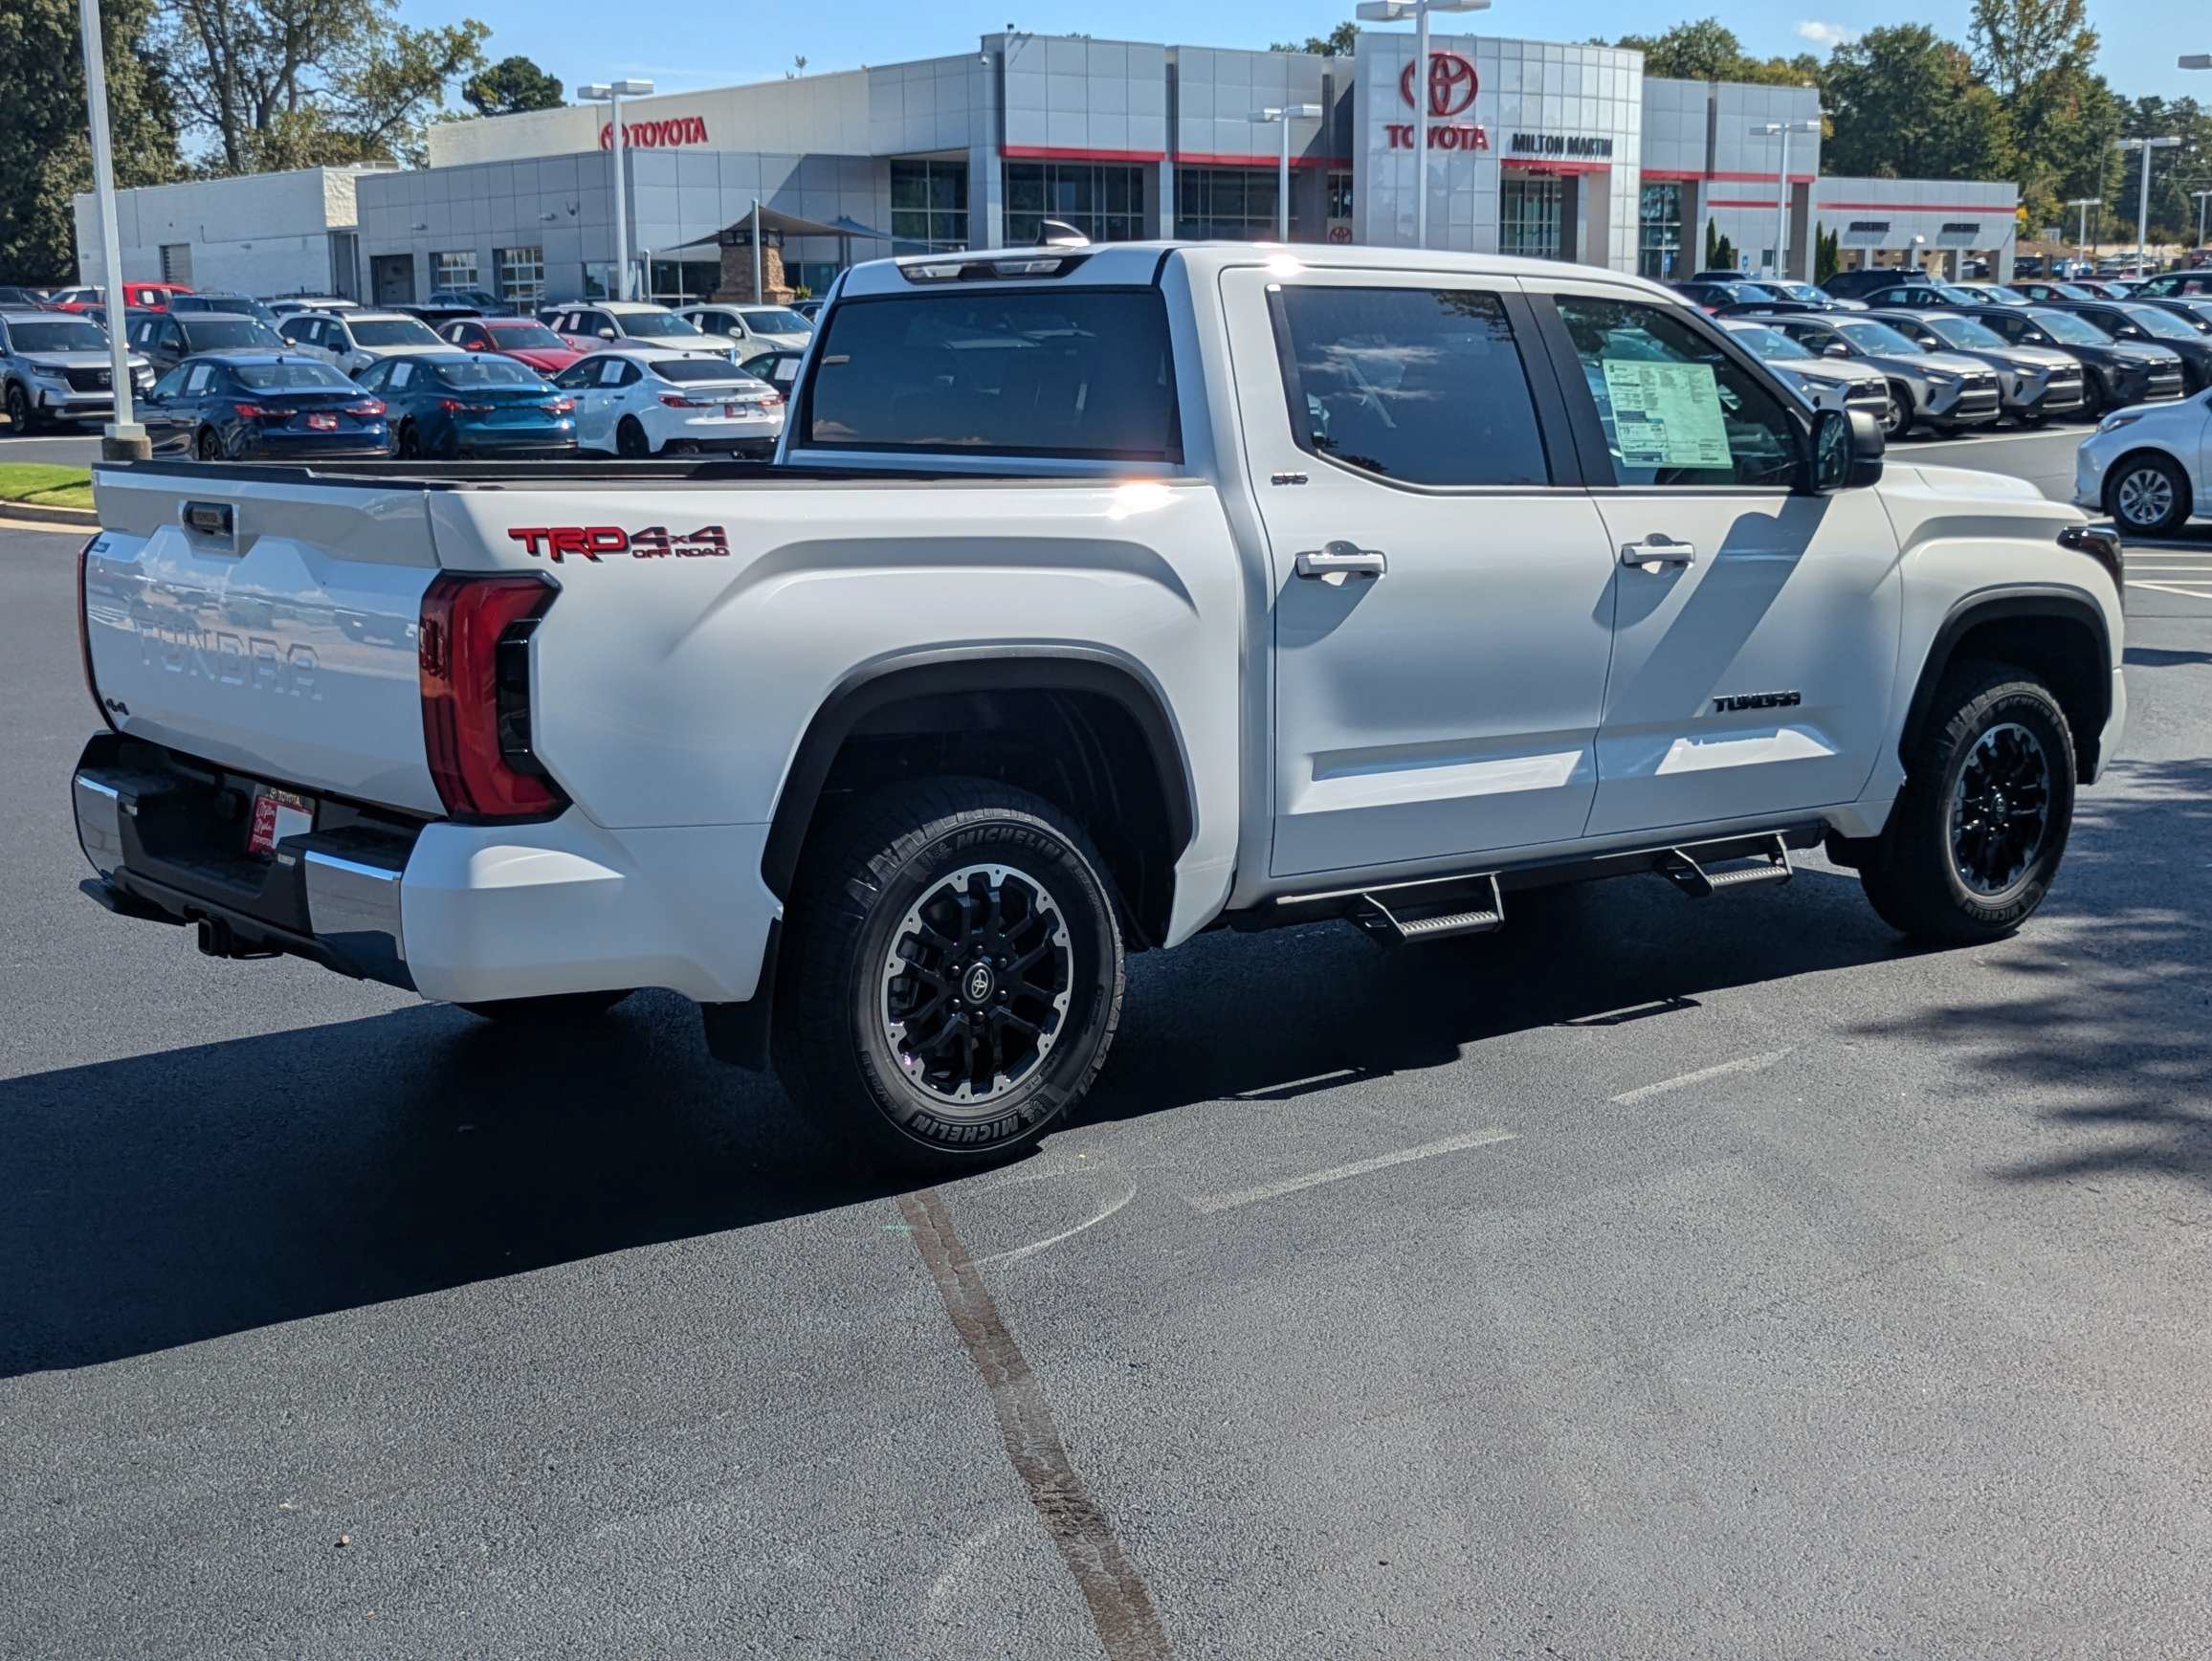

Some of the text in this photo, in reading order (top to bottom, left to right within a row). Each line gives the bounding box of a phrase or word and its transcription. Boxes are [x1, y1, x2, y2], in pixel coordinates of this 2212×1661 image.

[630, 116, 708, 148] TOYOTA
[1512, 133, 1614, 157] MILTON MARTIN
[508, 526, 630, 564] TRD
[631, 546, 731, 559] OFF ROAD
[958, 827, 1062, 861] MICHELIN
[911, 1113, 1019, 1141] MICHELIN
